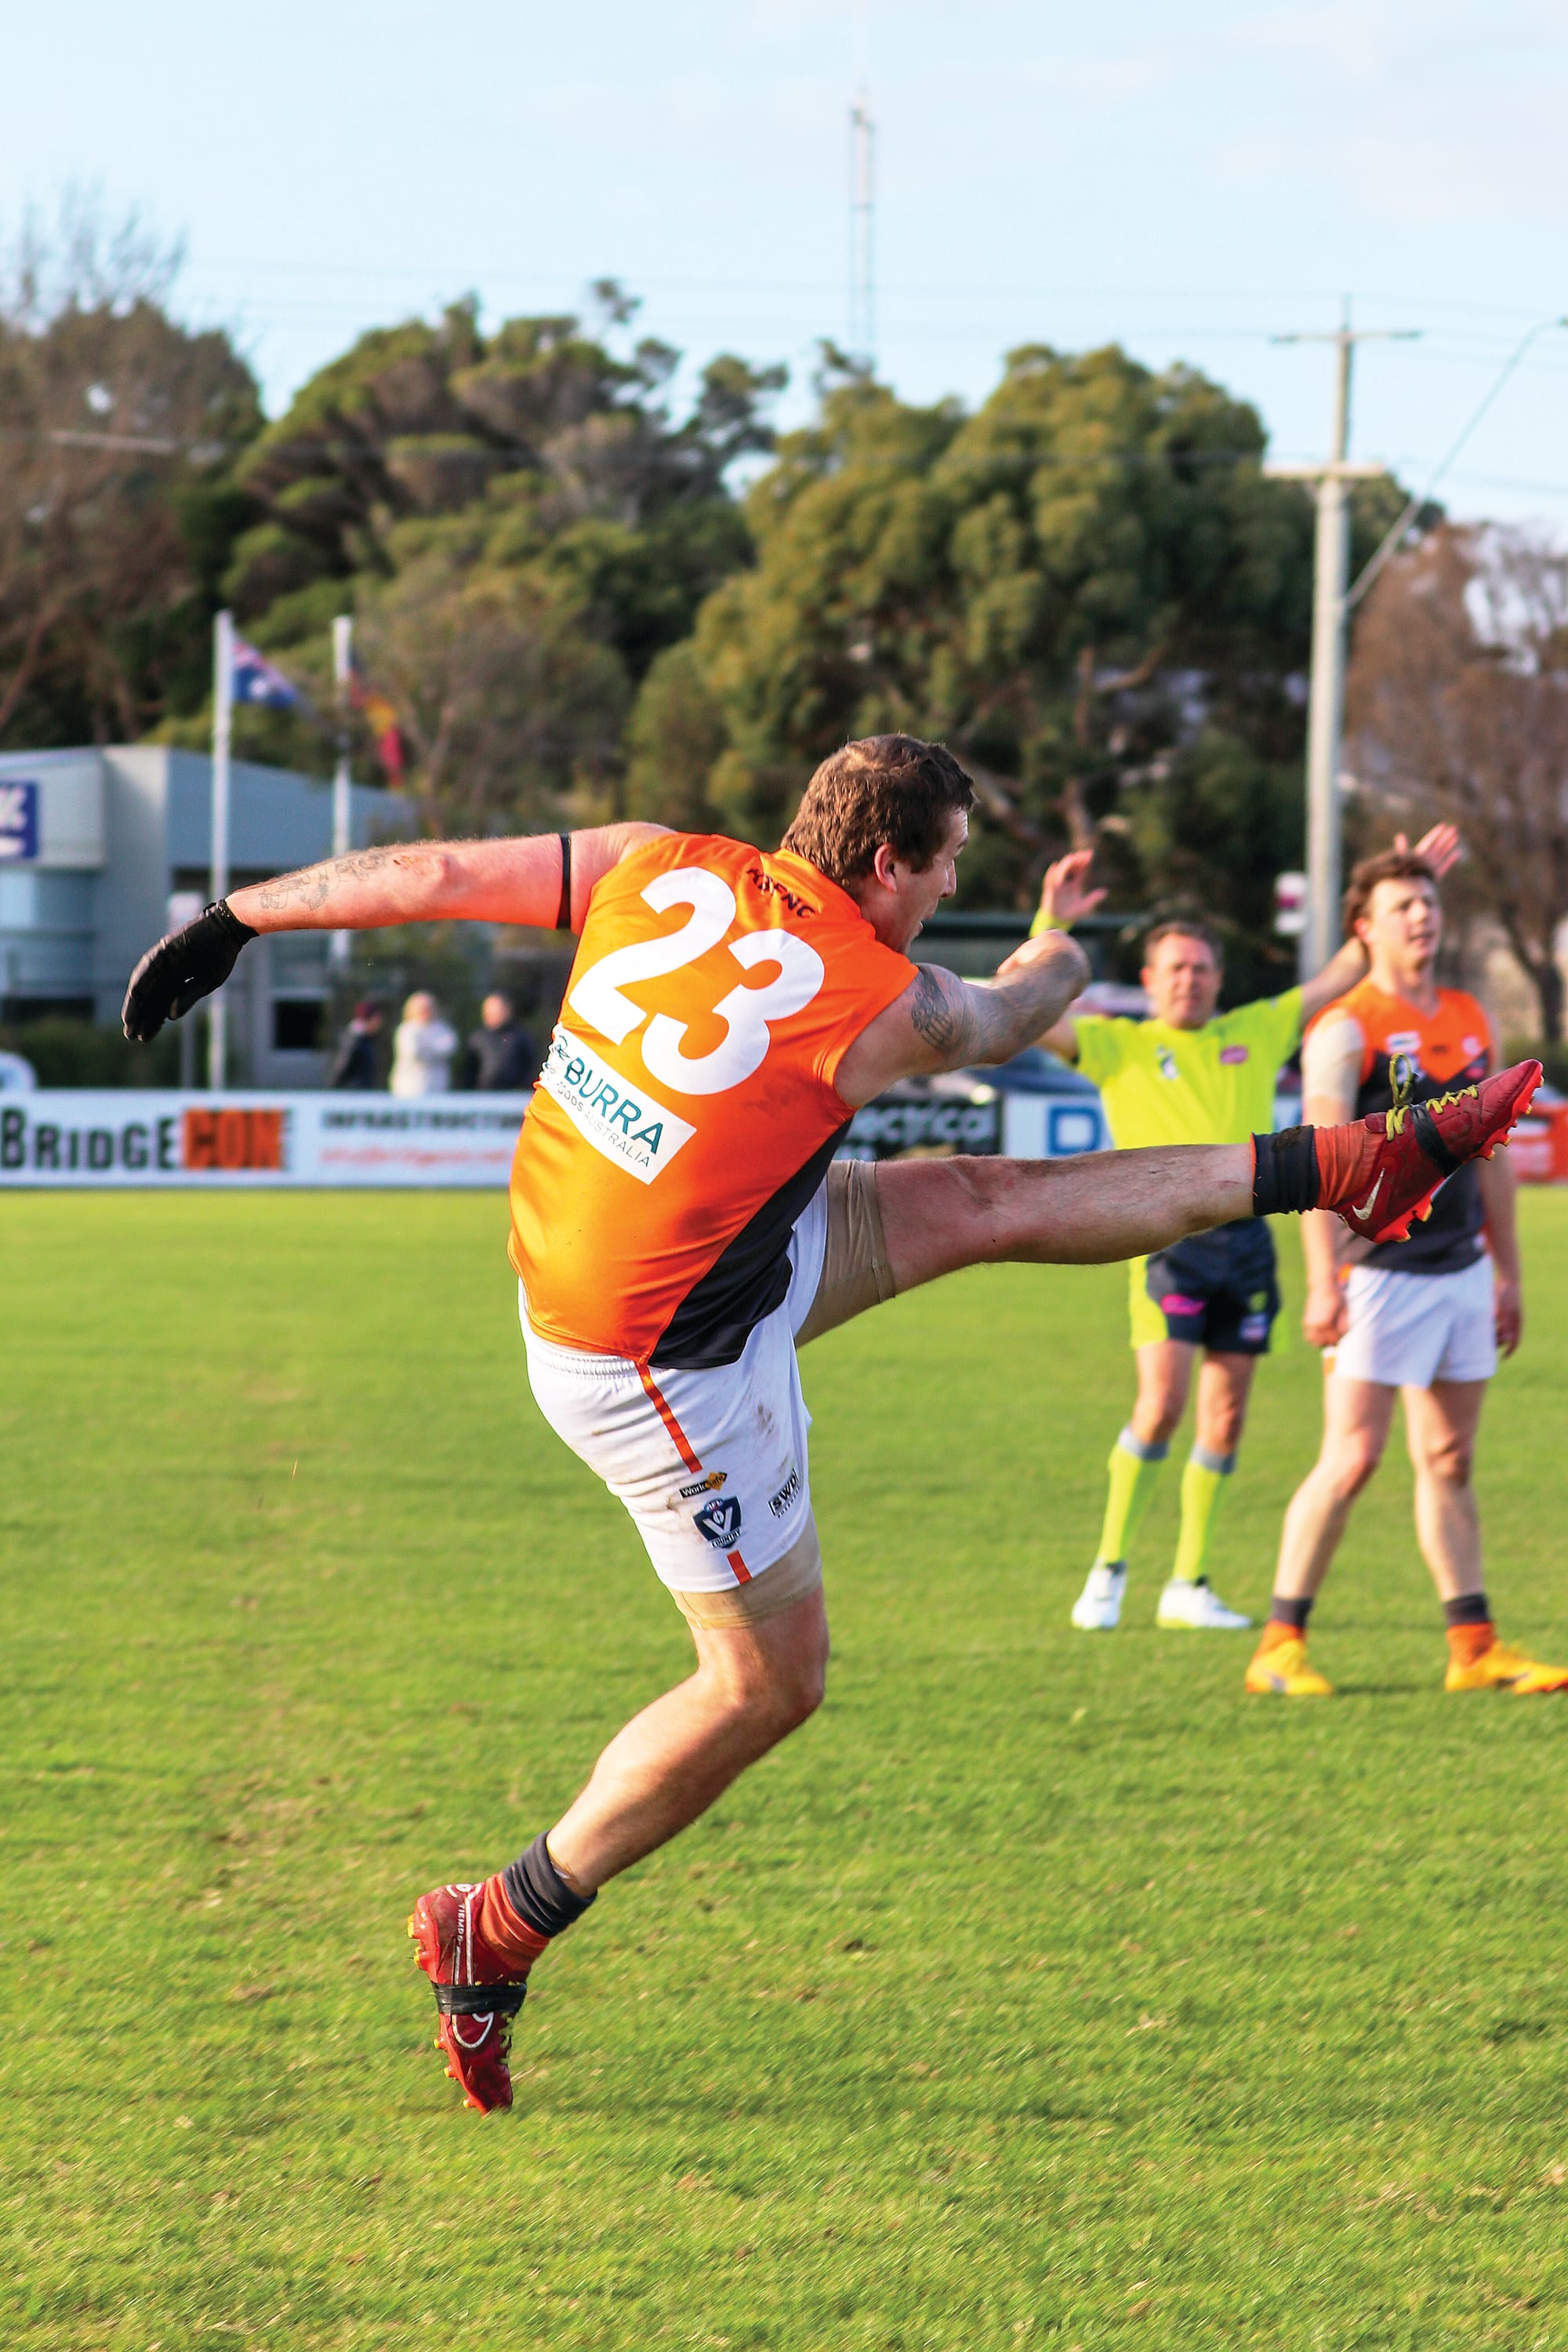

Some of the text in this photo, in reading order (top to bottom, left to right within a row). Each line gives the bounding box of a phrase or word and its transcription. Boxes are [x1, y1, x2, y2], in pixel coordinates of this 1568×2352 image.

[568, 866, 825, 1095] 23
[564, 1056, 664, 1155] BURRA
[584, 1110, 651, 1168] AUSTRALIA
[456, 1903, 466, 1942] TIEMPO
